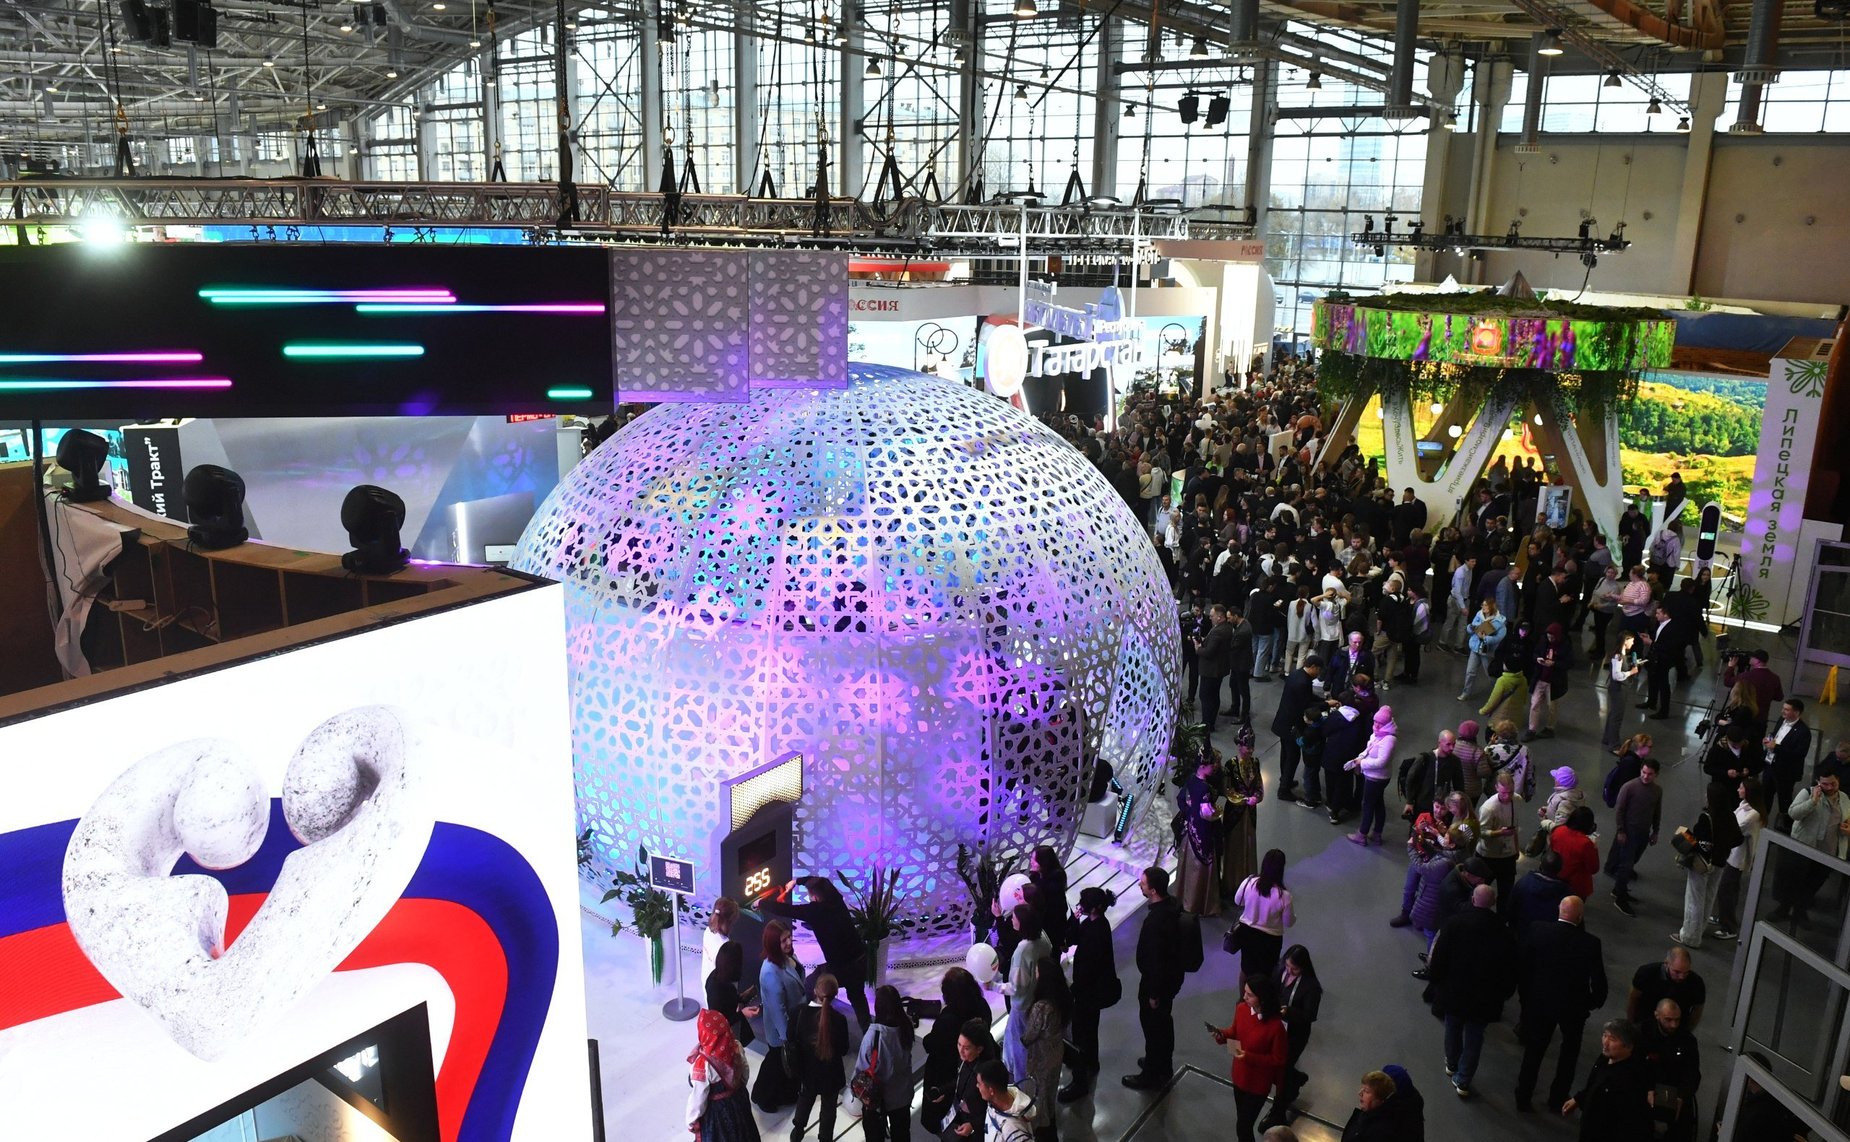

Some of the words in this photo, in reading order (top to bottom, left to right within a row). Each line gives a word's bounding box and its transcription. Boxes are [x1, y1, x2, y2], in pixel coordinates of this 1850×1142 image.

[849, 299, 899, 311] ОССИЯ
[1028, 338, 1143, 381] Татарстан
[1770, 408, 1798, 513] Липецкая
[1759, 519, 1777, 579] земля
[744, 867, 771, 897] 255
